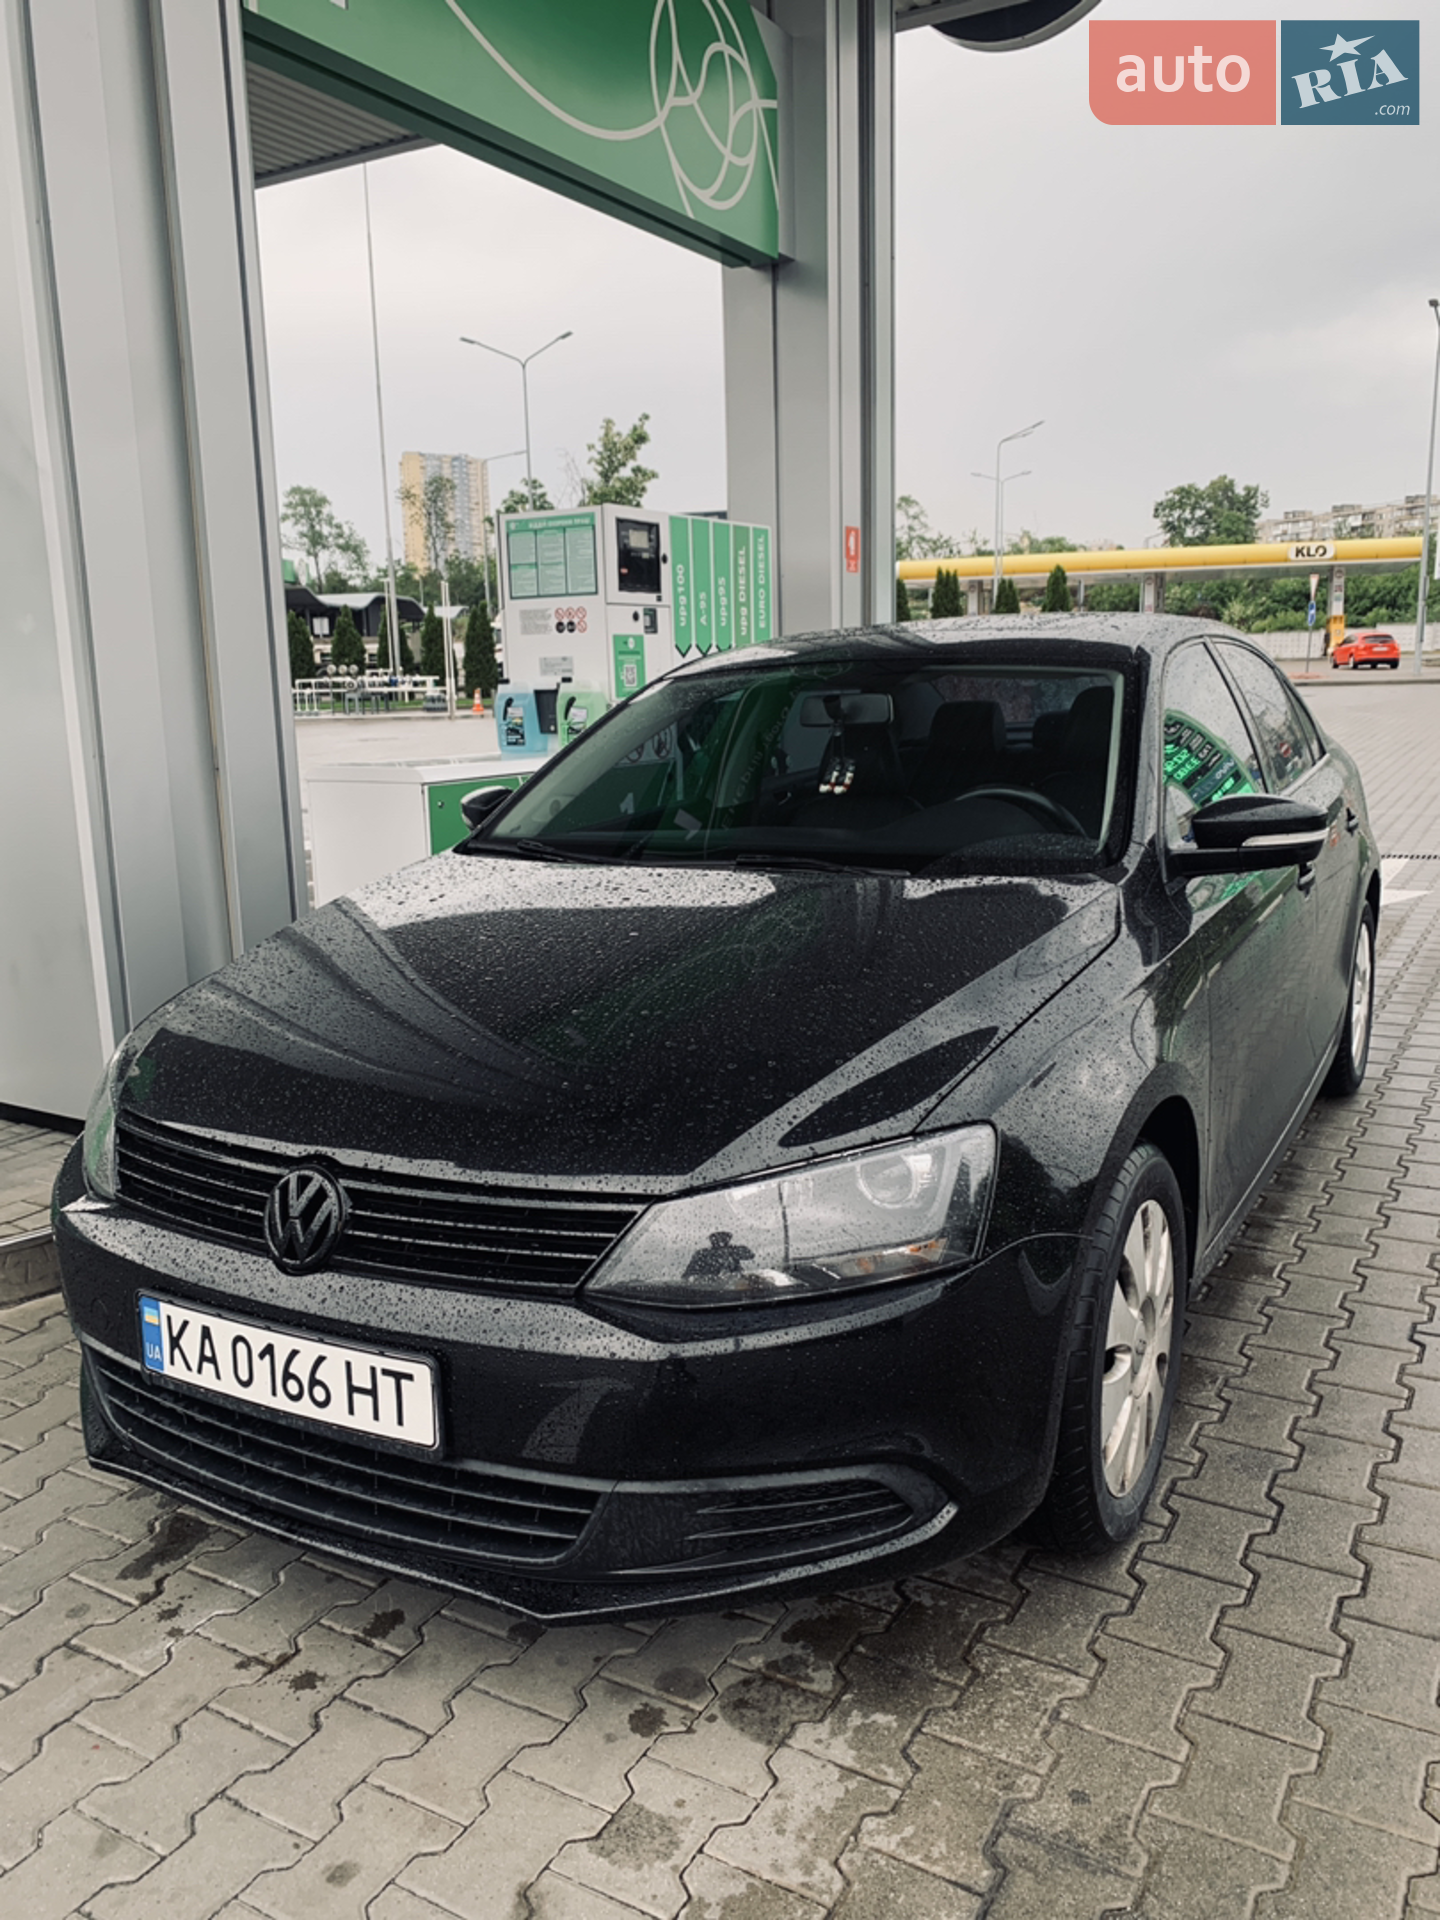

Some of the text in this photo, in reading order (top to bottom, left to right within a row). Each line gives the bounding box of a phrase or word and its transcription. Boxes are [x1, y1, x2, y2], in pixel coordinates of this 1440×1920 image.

[758, 534, 766, 628] EURO DIESEL
[1295, 545, 1327, 558] KLO
[676, 564, 687, 627] upg100
[718, 576, 728, 627] upg95
[738, 545, 748, 636] upg DIESEL
[146, 1342, 162, 1361] UA
[166, 1314, 415, 1427] KA 0166 HT
